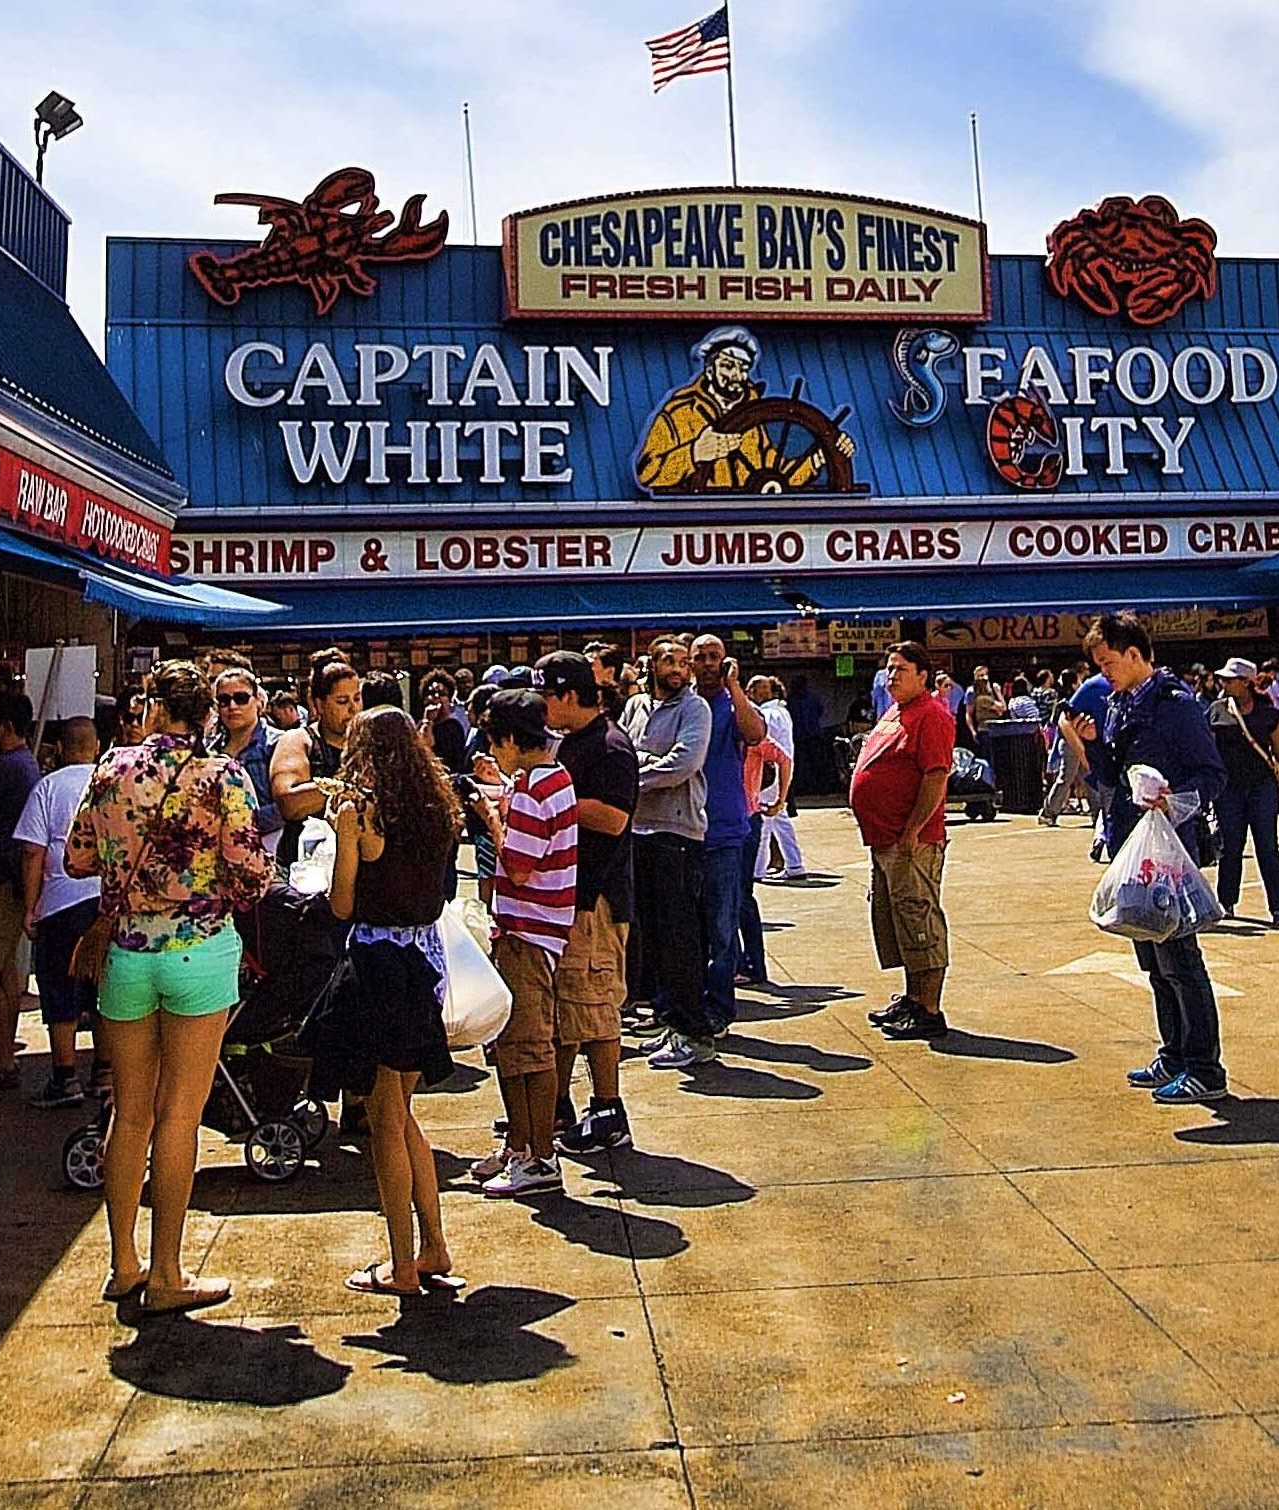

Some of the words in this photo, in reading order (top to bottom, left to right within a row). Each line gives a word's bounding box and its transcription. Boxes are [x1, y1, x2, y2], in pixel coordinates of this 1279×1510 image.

[539, 203, 745, 270] CHESAPEAKE
[758, 203, 845, 272] BAY'S
[858, 213, 959, 273] FINEST
[562, 274, 706, 300] FRESH
[720, 275, 811, 301] FISH
[826, 277, 942, 303] DAILY
[224, 342, 614, 408] CAPTAIN
[279, 420, 572, 484] WHITE
[17, 469, 48, 516] RAW
[44, 483, 68, 526] BAR
[81, 500, 105, 540] HOT
[168, 537, 336, 576] SHRIMP
[360, 537, 389, 572] &
[415, 534, 612, 571] LOBSTER
[661, 530, 803, 567] JUMBO
[825, 529, 961, 562] CRABS
[1008, 523, 1168, 557] COOKED
[980, 615, 1060, 641] CRAB
